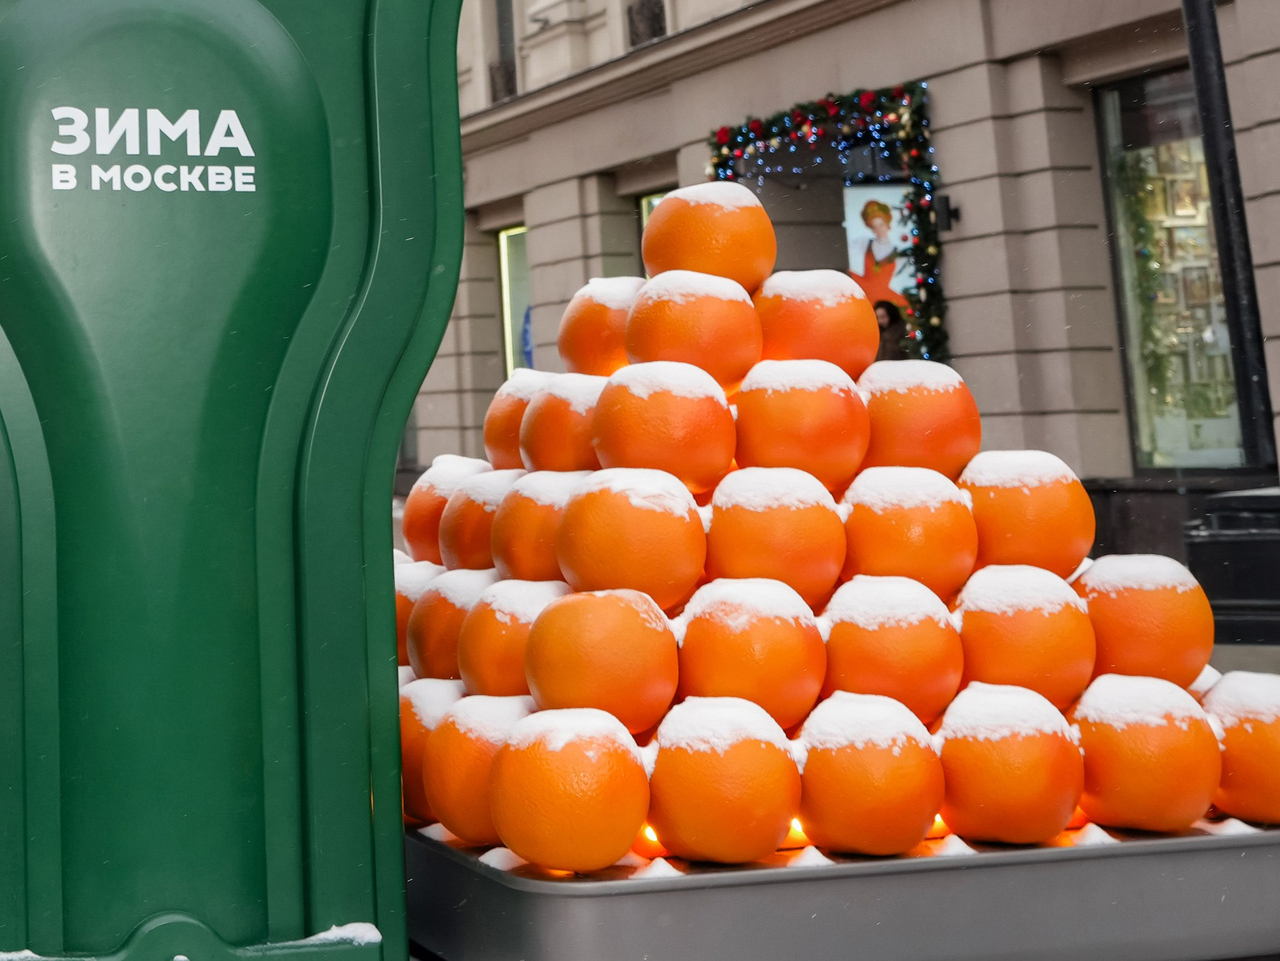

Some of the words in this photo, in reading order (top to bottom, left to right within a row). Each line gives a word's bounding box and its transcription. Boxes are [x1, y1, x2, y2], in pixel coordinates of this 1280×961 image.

[50, 106, 256, 157] ЗИМА
[51, 163, 78, 190] В
[91, 164, 257, 192] МОСКВЕ
